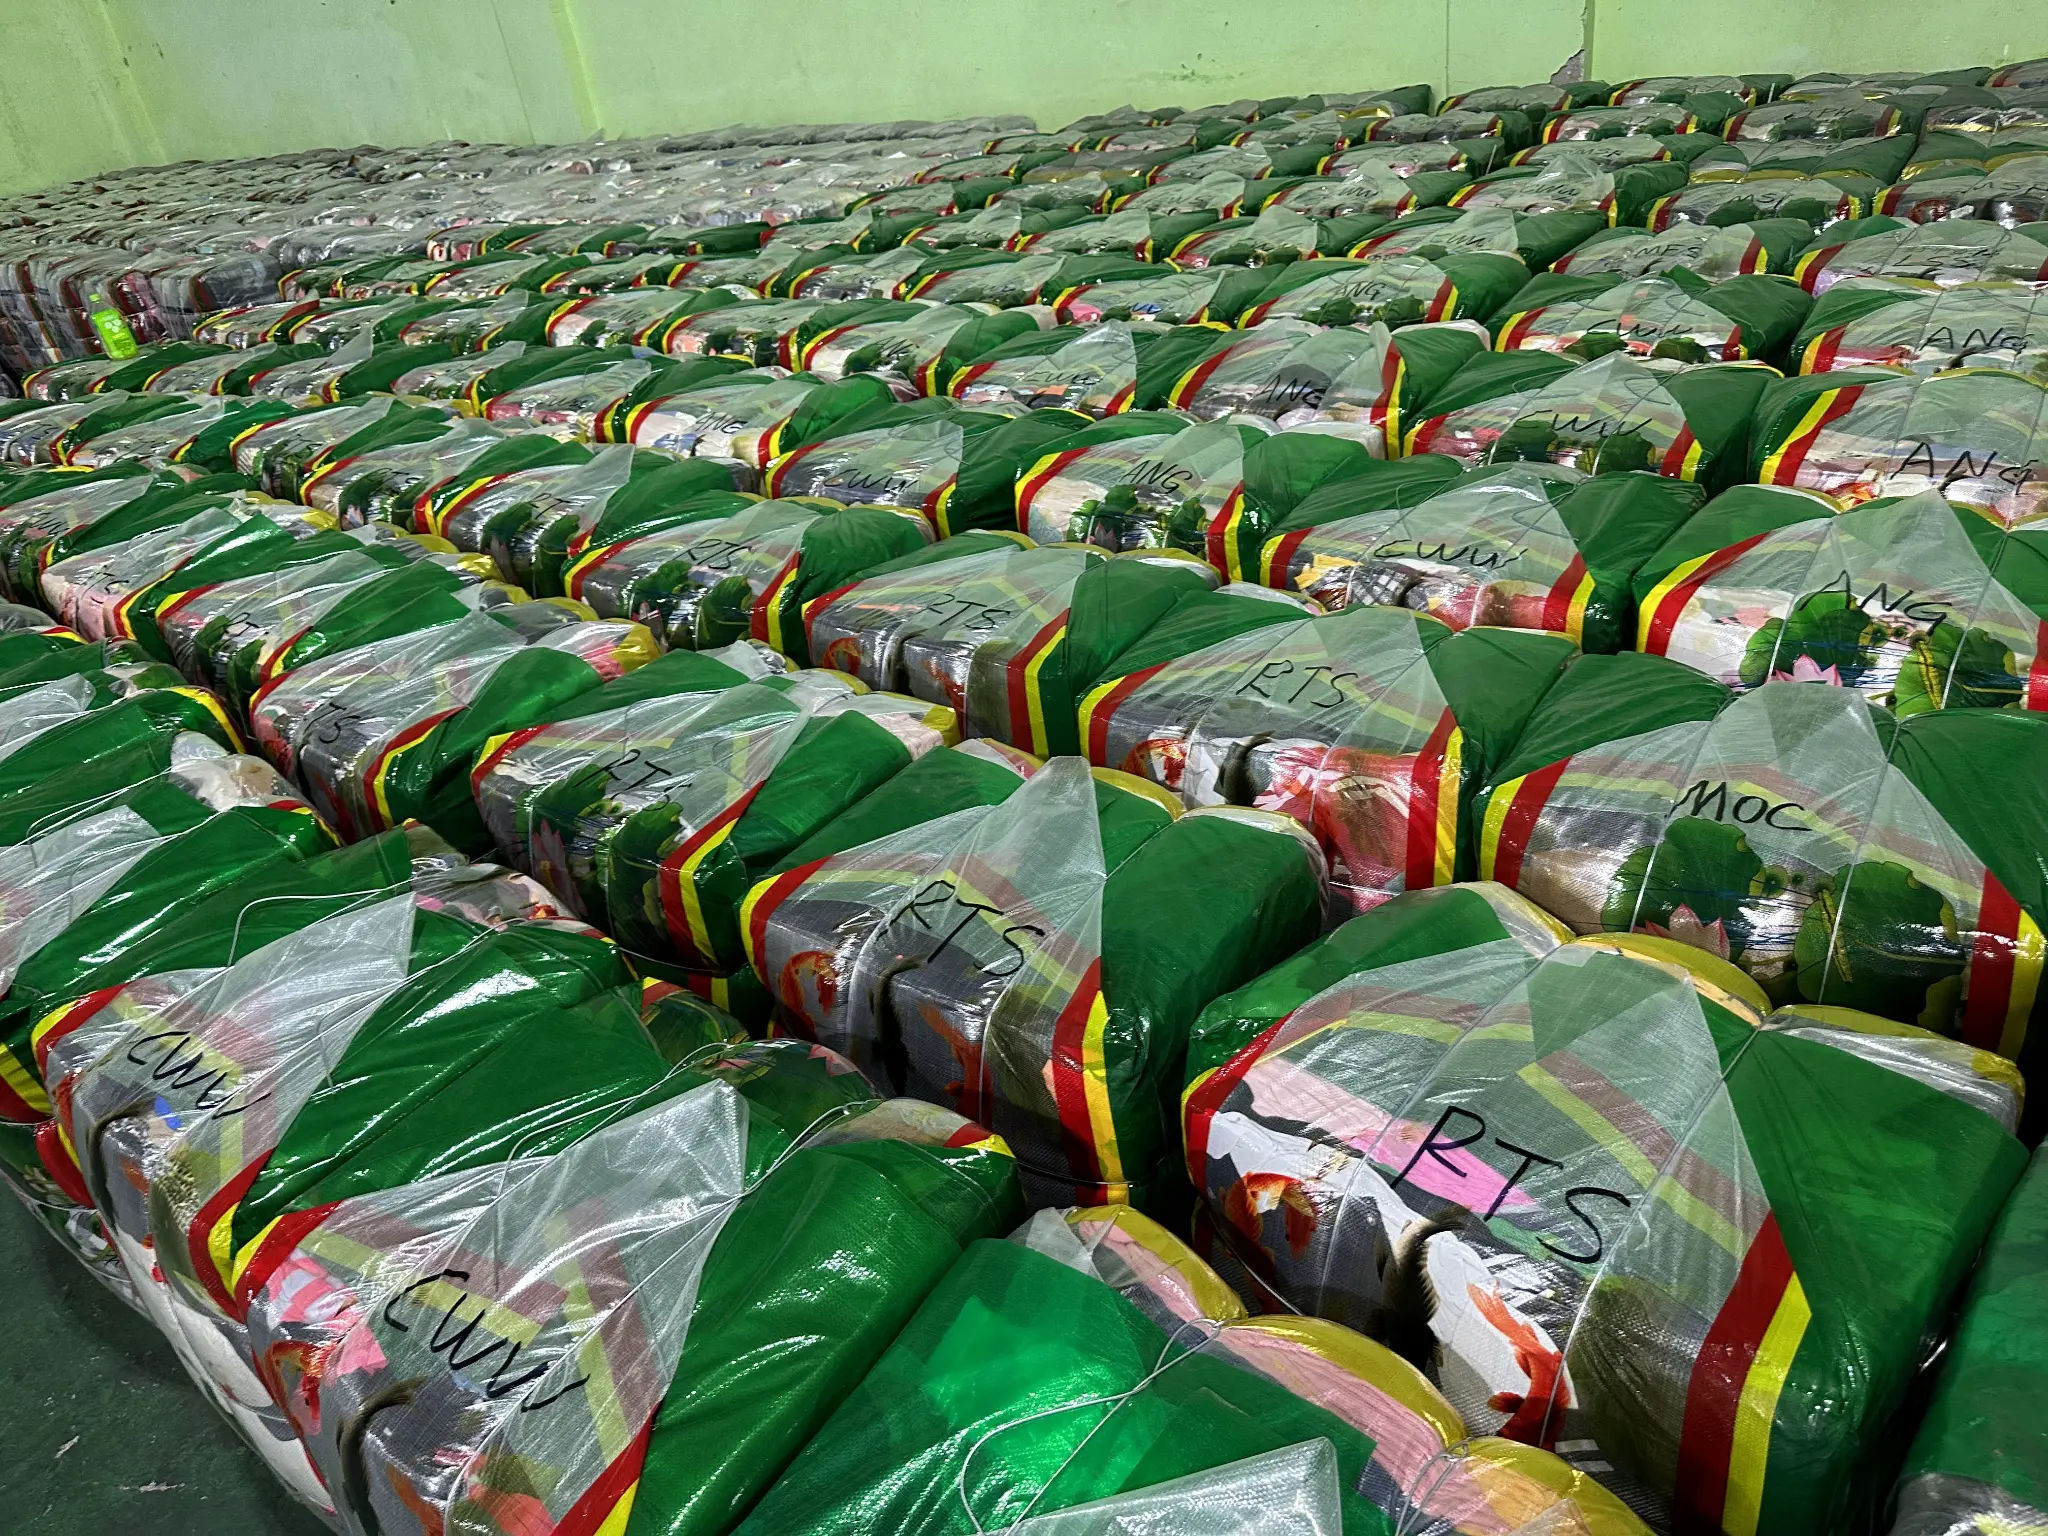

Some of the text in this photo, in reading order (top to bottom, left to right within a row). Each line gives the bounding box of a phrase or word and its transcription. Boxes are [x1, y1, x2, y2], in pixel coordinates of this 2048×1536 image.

[1332, 280, 1386, 299] ANG
[1918, 326, 2035, 356] ANG
[1248, 374, 1328, 408] ANG
[694, 411, 748, 435] ANG
[1511, 409, 1653, 438] CWW
[1120, 460, 1192, 495] ANG
[1890, 441, 2040, 496] ANG
[672, 538, 752, 570] RTS
[1373, 538, 1529, 570] CWW
[922, 592, 1012, 630] RTS
[1798, 569, 1953, 637] ANG
[200, 611, 270, 651] RT
[1235, 658, 1358, 709] RTS
[302, 701, 362, 745] TS
[1664, 779, 1813, 832] MOC
[876, 879, 1046, 977] RTS
[126, 1030, 272, 1119] CWW
[1390, 1105, 1631, 1264] RTS
[383, 1268, 590, 1413] CWW
